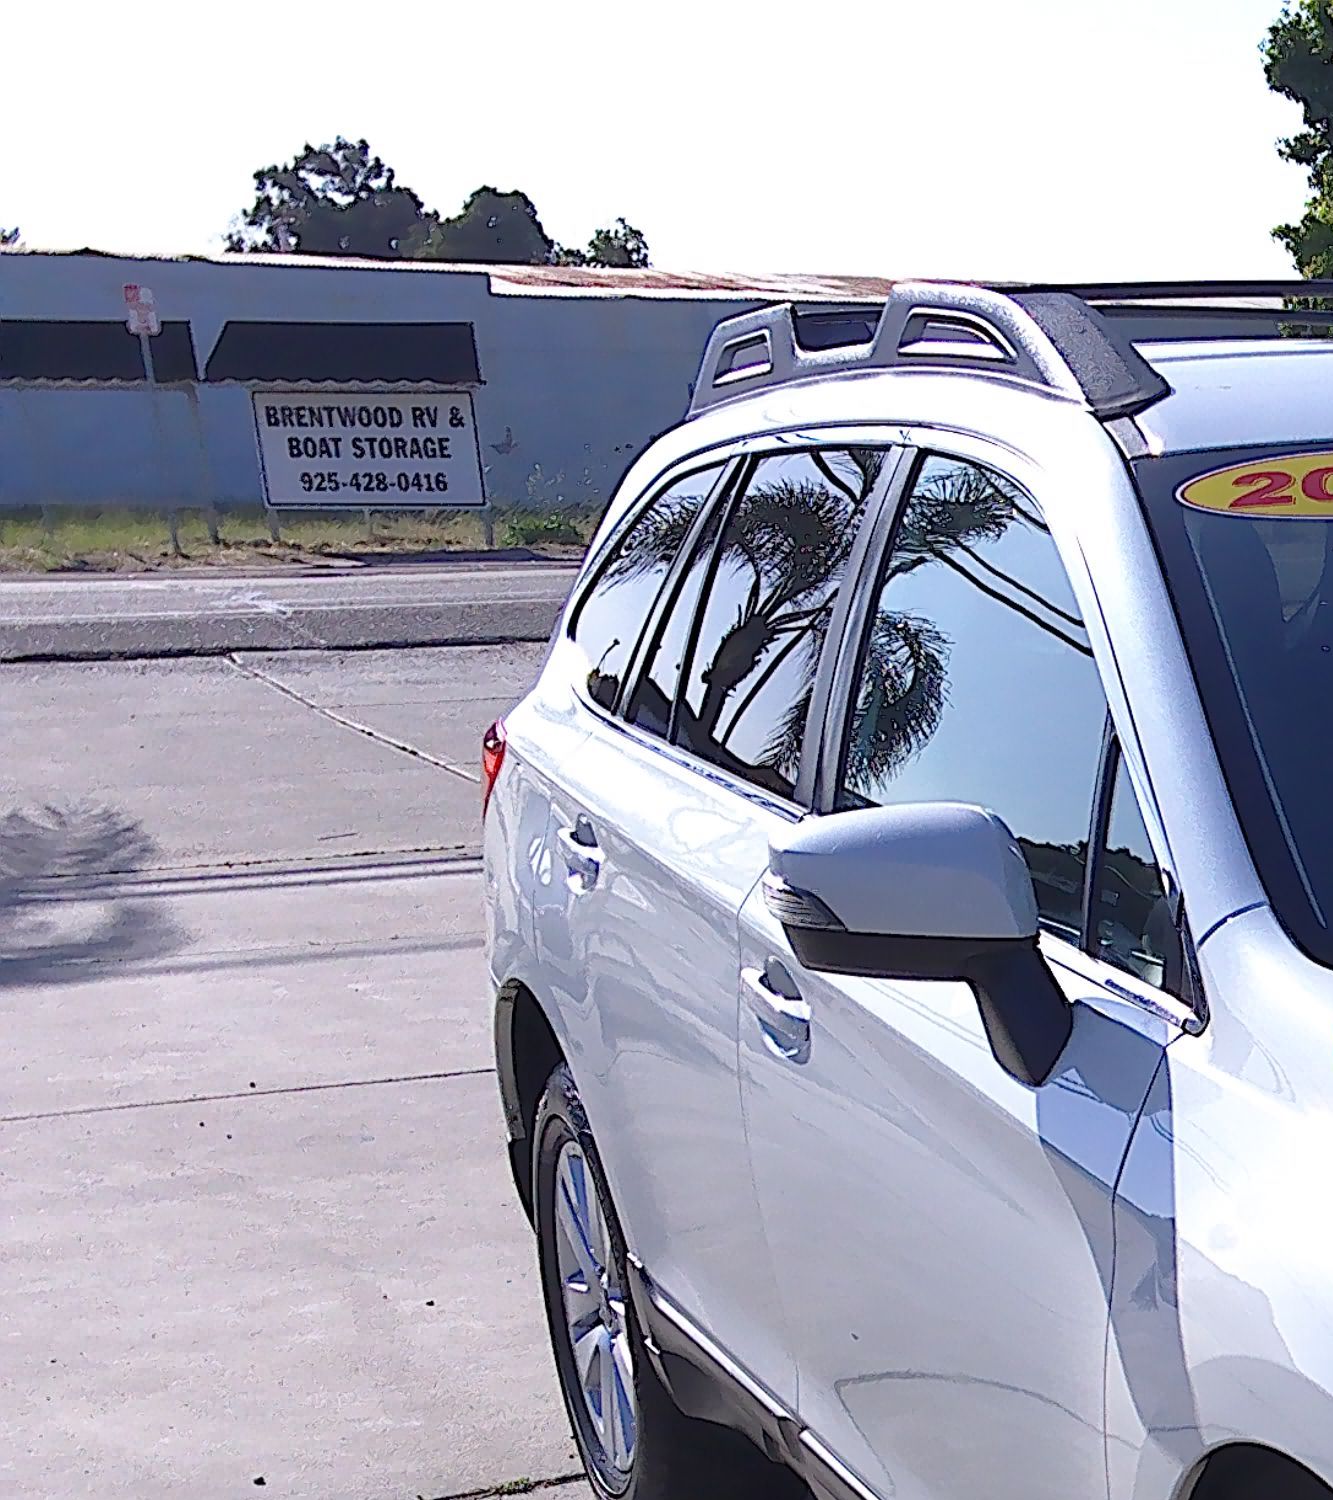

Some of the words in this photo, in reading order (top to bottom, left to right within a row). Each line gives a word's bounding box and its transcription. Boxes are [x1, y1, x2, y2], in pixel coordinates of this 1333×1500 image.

[264, 405, 403, 428] BRENTWOOD
[411, 405, 438, 428] RV
[448, 406, 465, 428] &
[287, 436, 342, 459] BOAT
[352, 436, 452, 459] STORAGE
[299, 471, 449, 493] 925-428-0416
